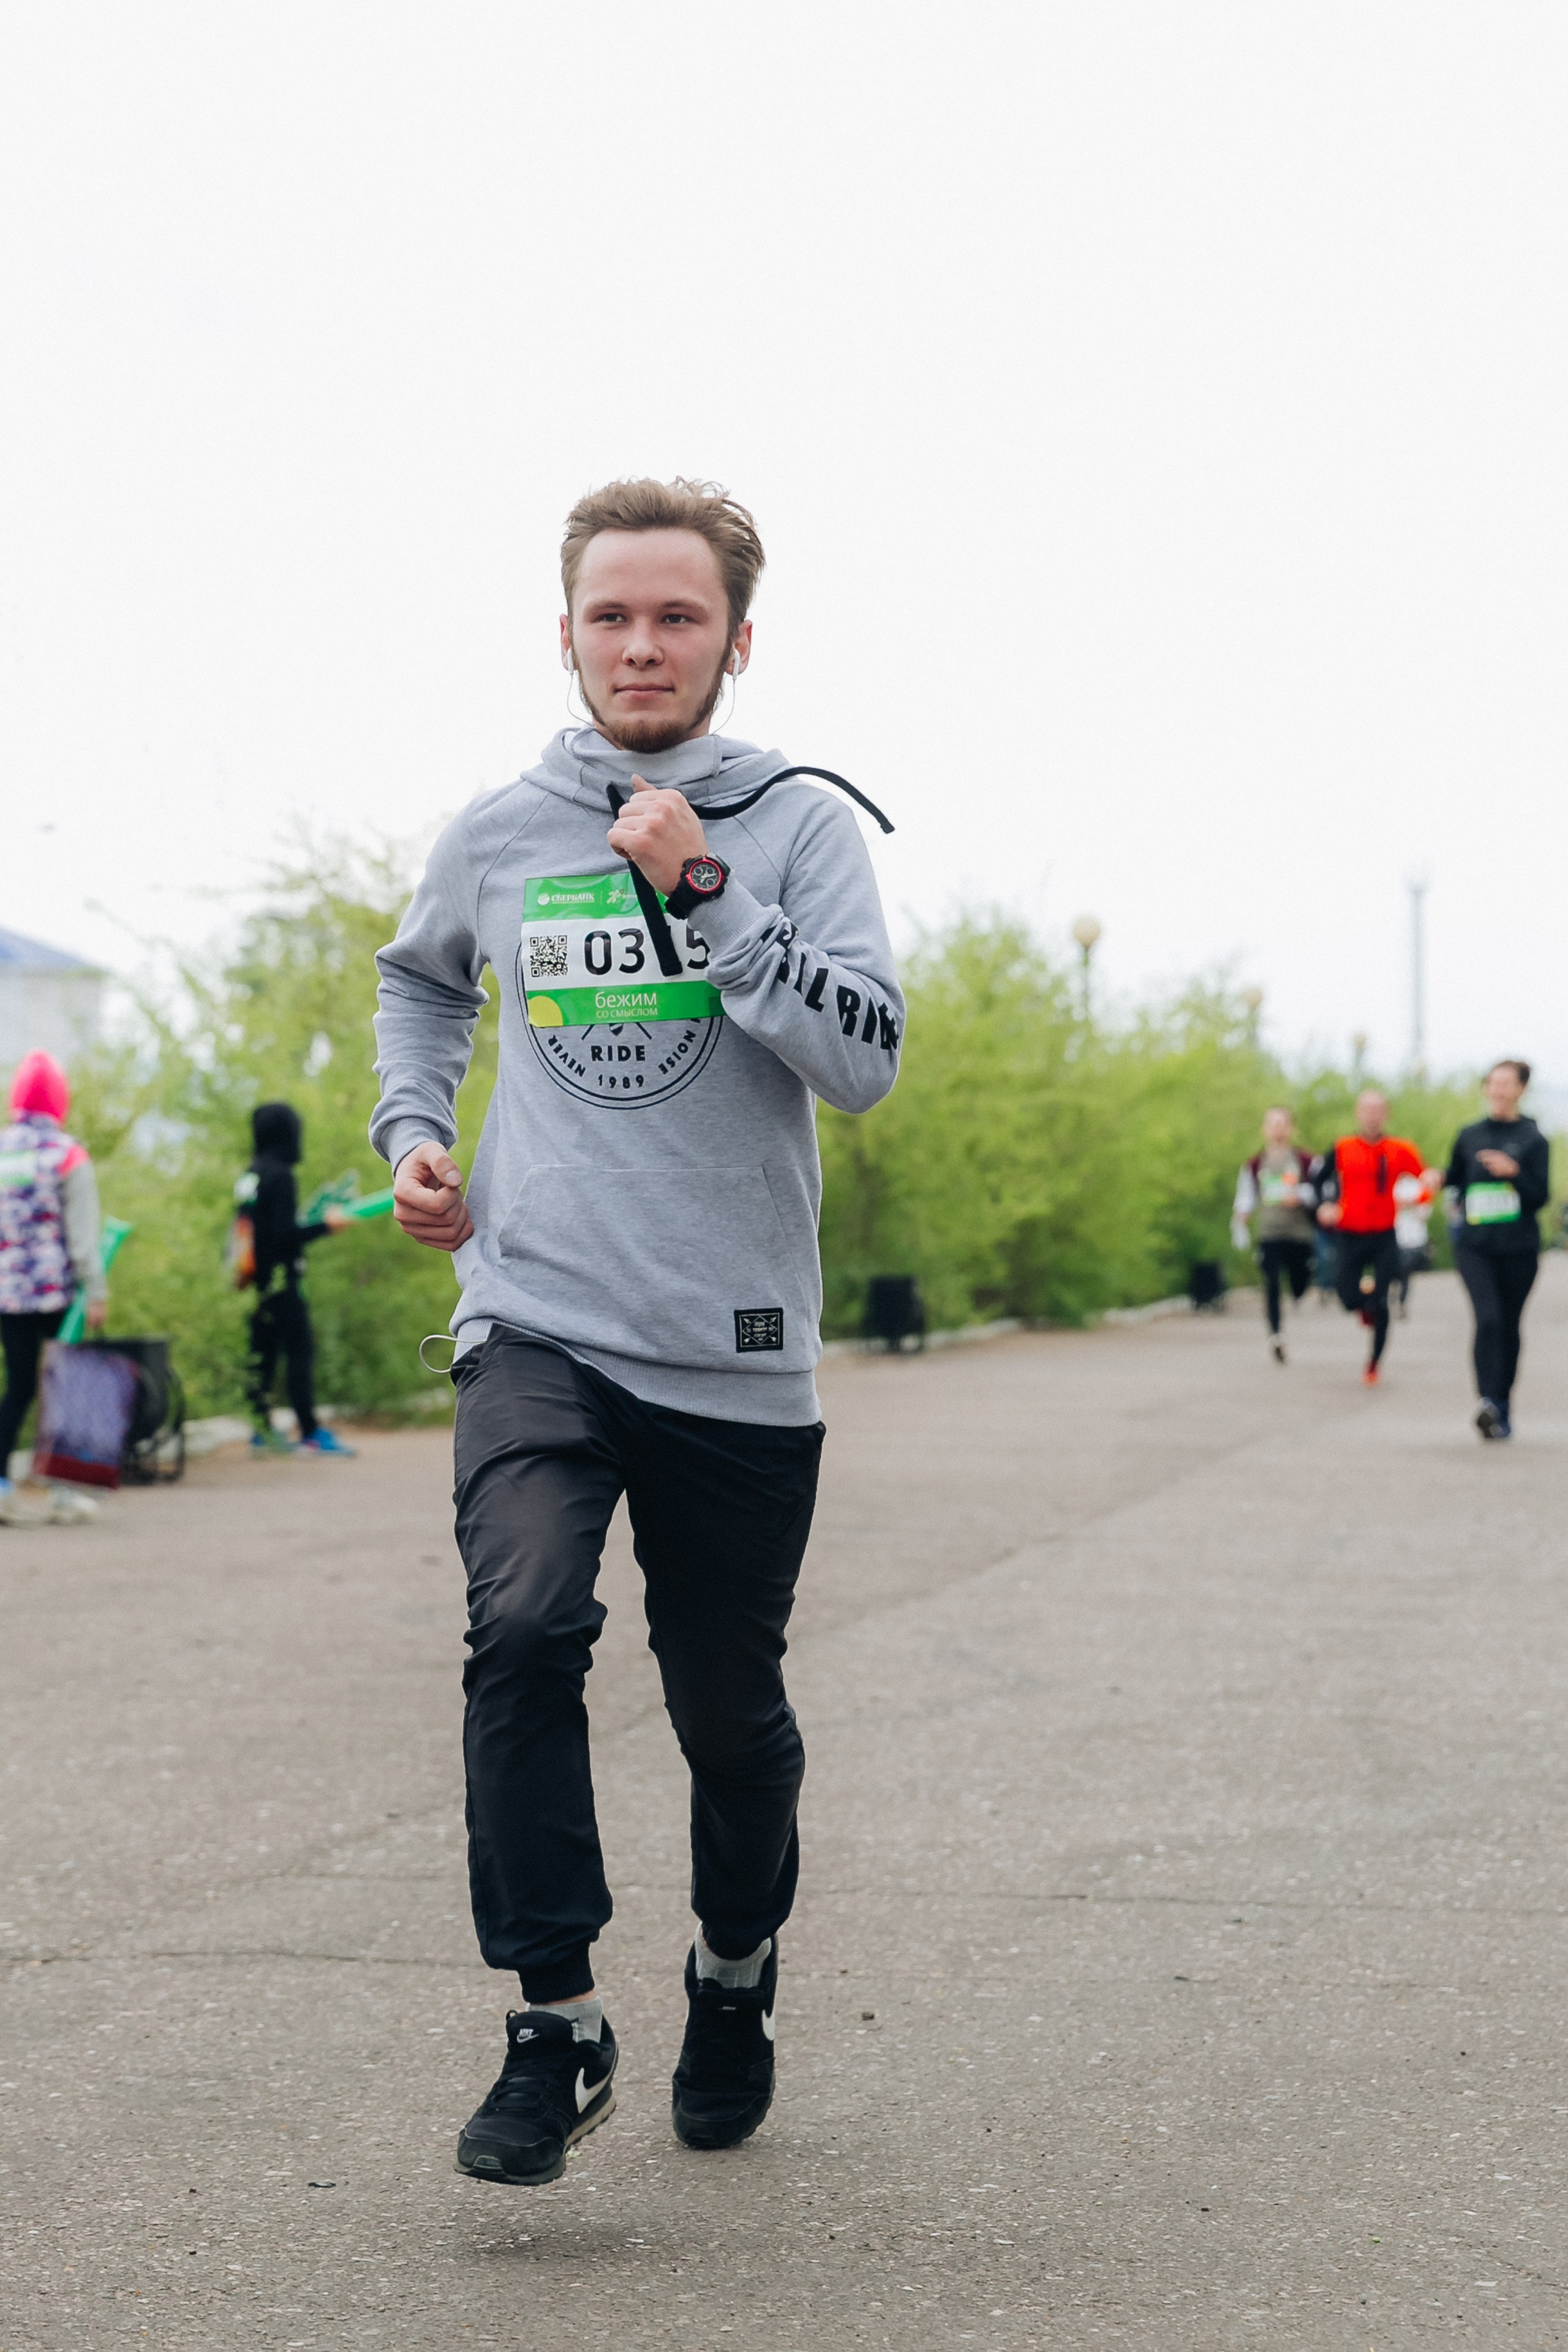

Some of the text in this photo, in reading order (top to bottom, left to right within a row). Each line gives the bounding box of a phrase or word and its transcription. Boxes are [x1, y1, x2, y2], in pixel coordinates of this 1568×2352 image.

[584, 924, 710, 975] 035
[595, 991, 657, 1008] бежим
[548, 1035, 586, 1077] NEVER
[591, 1045, 646, 1062] RIDE
[658, 1030, 696, 1075] NOISE
[598, 1074, 644, 1089] 1989
[519, 2029, 533, 2037] NIKE
